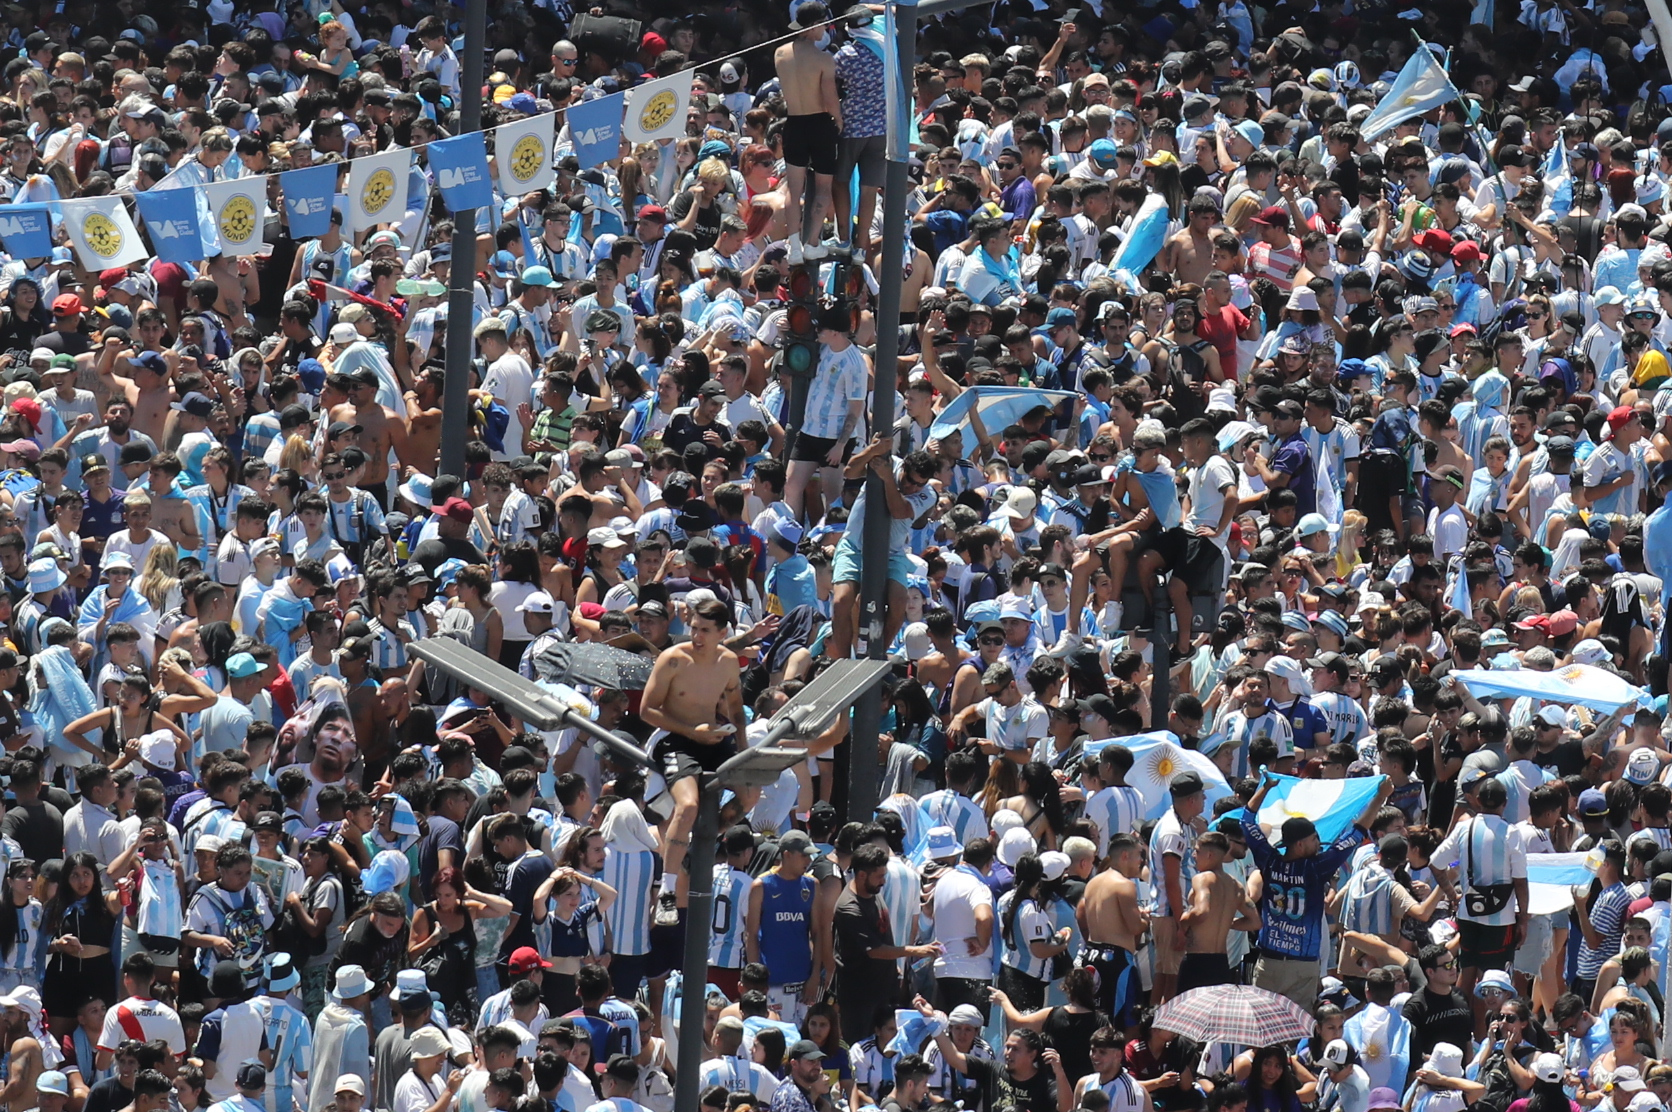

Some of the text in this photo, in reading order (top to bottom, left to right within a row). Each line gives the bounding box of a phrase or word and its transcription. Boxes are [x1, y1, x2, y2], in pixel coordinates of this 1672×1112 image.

[642, 111, 673, 129] MUNDIAL
[513, 161, 541, 178] MUNDIAL
[364, 194, 391, 211] MUNDIAL
[222, 224, 254, 240] MUNDIAL
[88, 239, 120, 255] MUNDIAL
[1335, 712, 1361, 725] MARIA
[1271, 871, 1304, 884] MARTIN
[1268, 883, 1305, 920] 30
[776, 912, 804, 922] BBVA
[16, 929, 29, 943] 10
[1269, 929, 1280, 938] EL
[1268, 938, 1300, 952] TIEMPO
[131, 1008, 162, 1018] LUBRAX
[724, 1079, 746, 1089] MESSI
